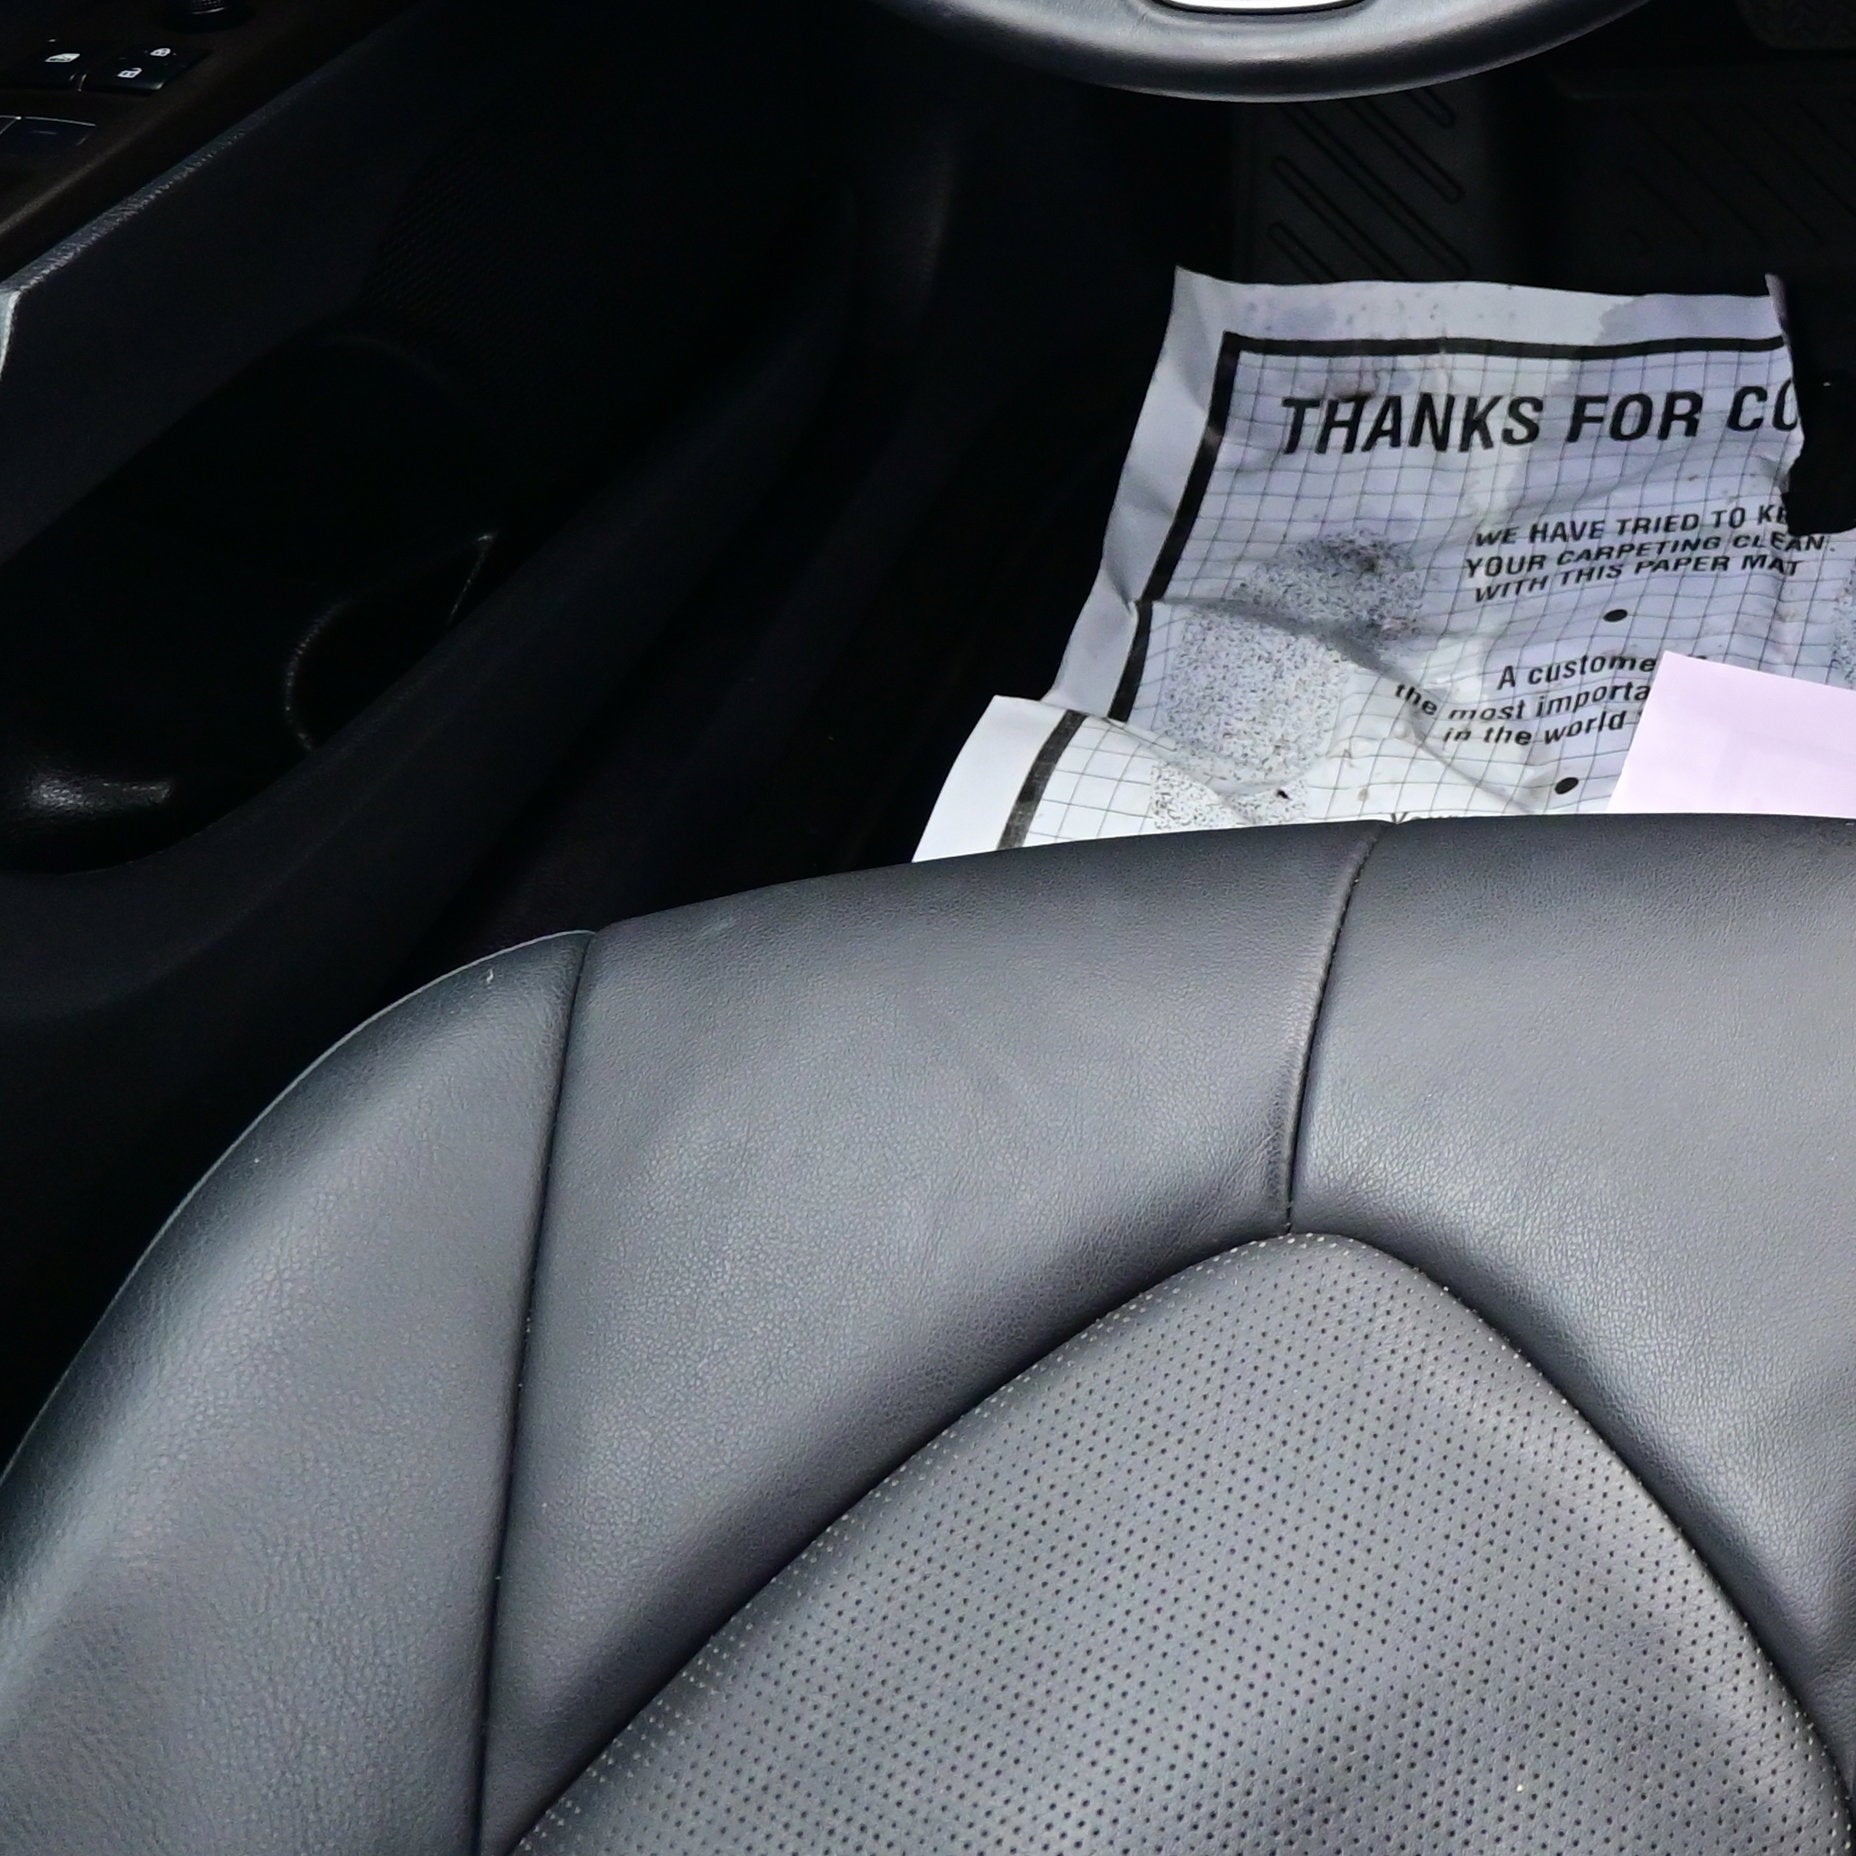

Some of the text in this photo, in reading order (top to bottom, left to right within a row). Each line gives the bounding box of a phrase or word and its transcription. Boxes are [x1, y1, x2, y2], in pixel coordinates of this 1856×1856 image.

[1281, 392, 1543, 455] THANKS
[1566, 393, 1703, 443] FOR
[1474, 507, 1745, 547] WE HAVE TRIED TO
[1466, 554, 1545, 578] YOUR
[1555, 535, 1720, 567] CARPETING
[1474, 555, 1806, 603] WITH THIS PAPER MAT
[1497, 666, 1516, 690] A
[1394, 683, 1438, 717] the
[1448, 696, 1524, 721] most
[1443, 726, 1473, 744] in
[1482, 724, 1533, 746] the
[1543, 710, 1626, 745] world
